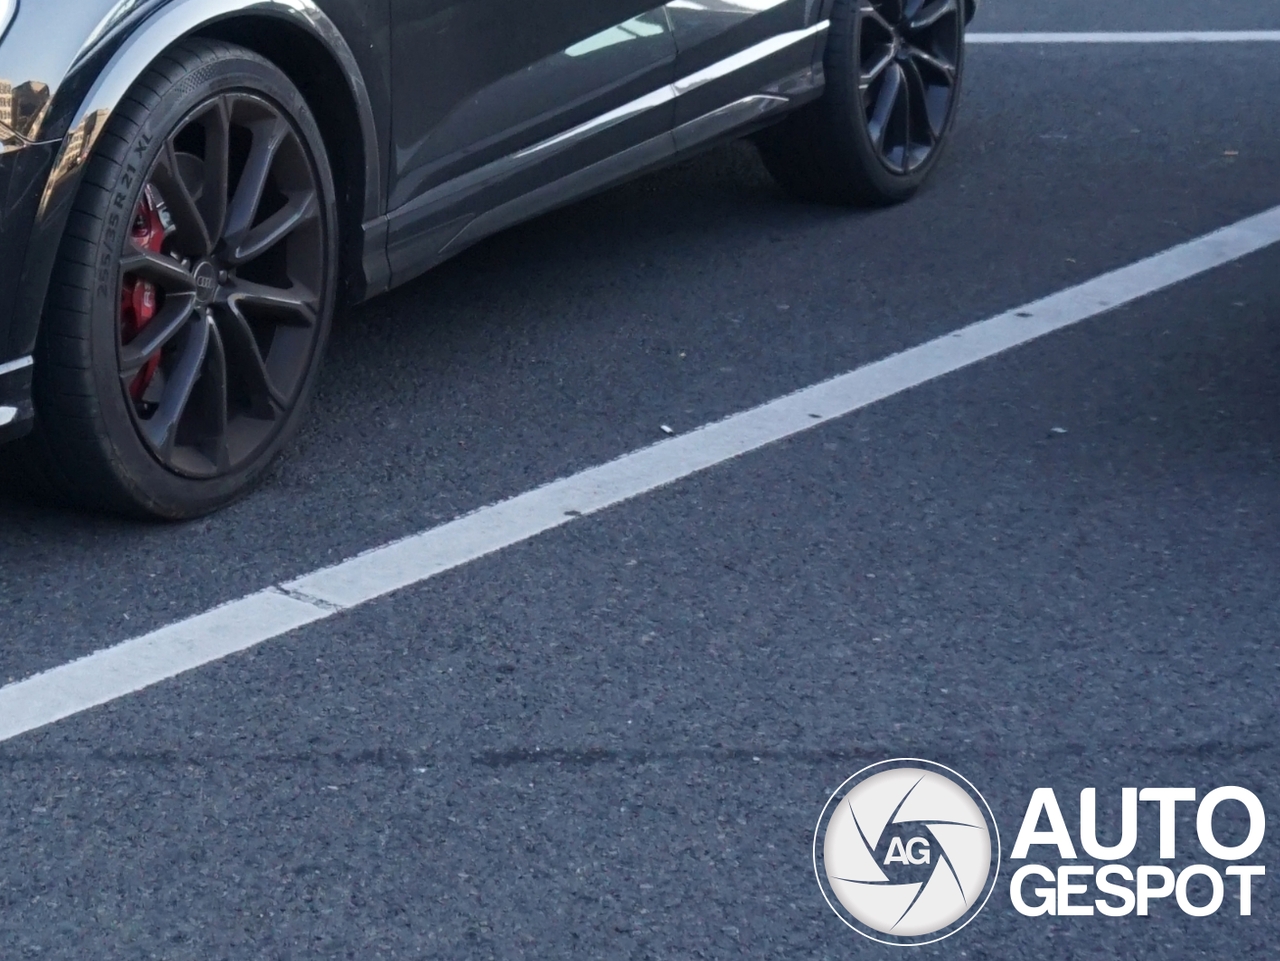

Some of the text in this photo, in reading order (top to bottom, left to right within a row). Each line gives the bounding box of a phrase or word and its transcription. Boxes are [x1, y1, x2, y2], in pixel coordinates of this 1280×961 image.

[97, 134, 154, 298] 255/35 R 21 XL
